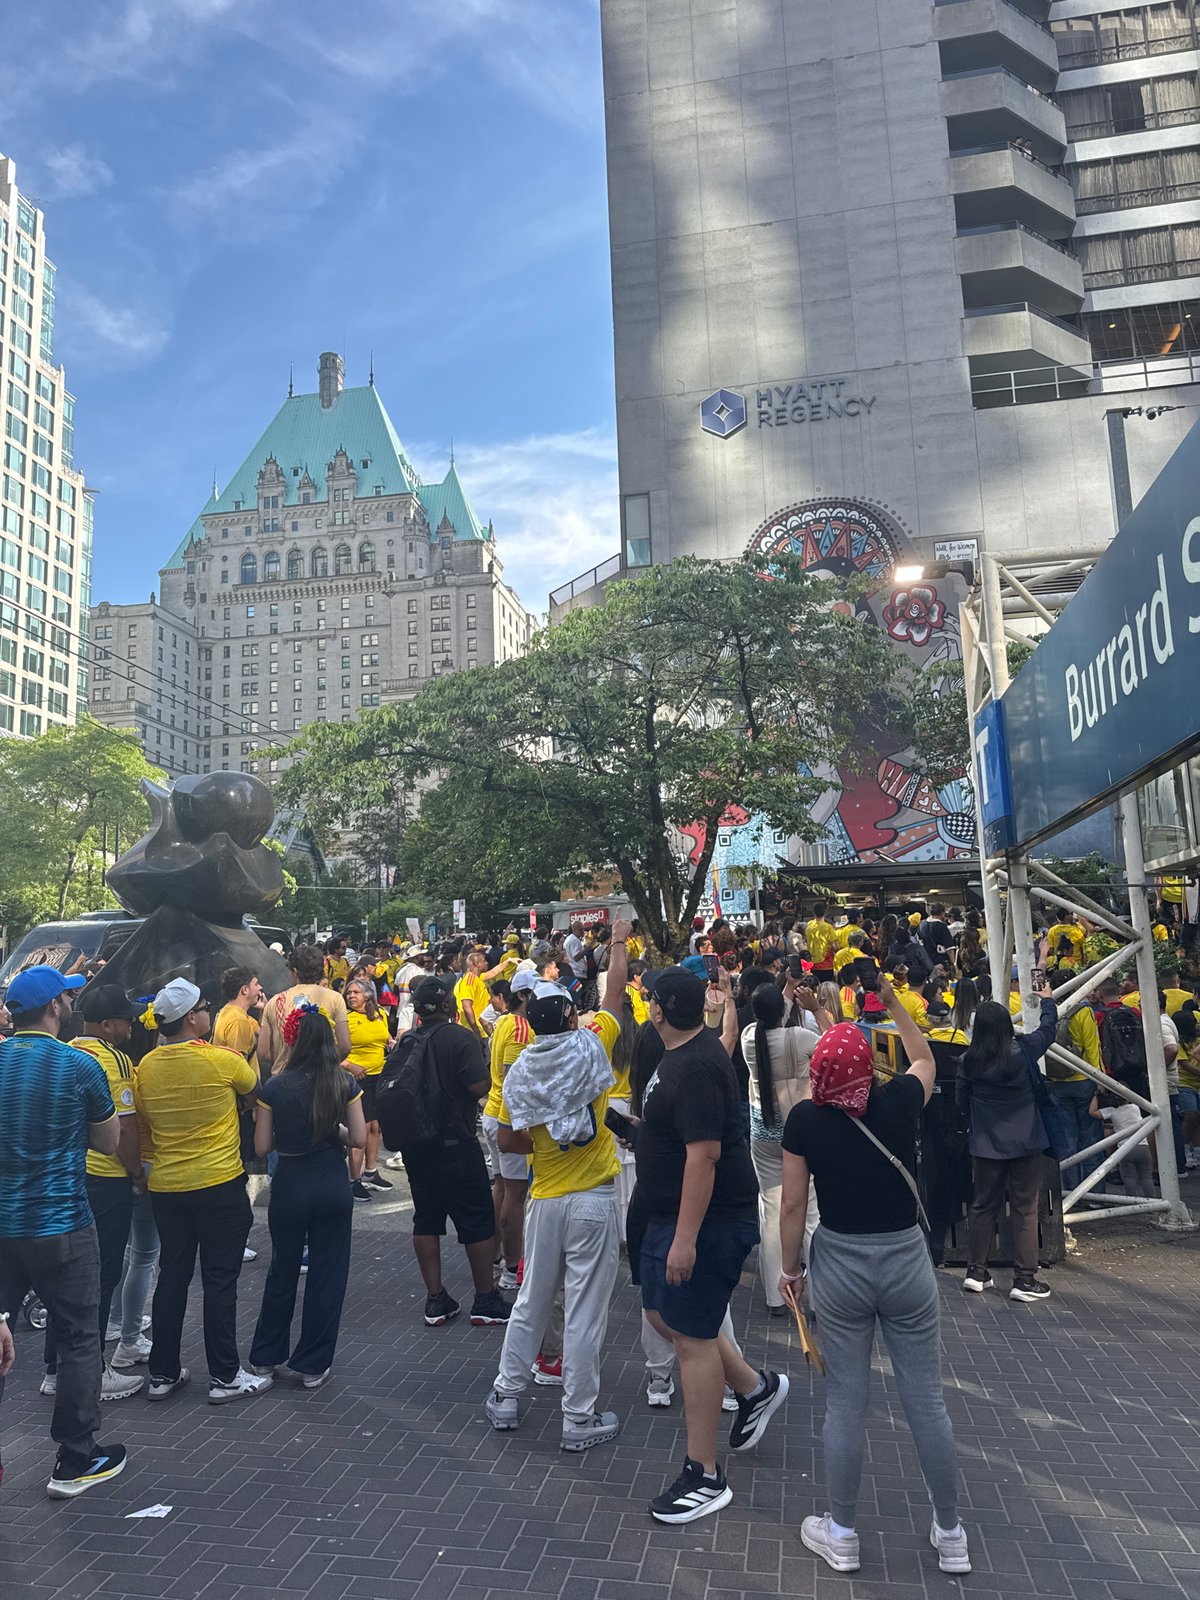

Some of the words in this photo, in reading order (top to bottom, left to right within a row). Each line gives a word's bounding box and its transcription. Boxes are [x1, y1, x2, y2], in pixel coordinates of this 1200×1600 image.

[756, 381, 845, 408] HYATT
[758, 396, 876, 428] REGENCY
[1065, 553, 1175, 743] Burrard
[570, 911, 599, 925] staples
